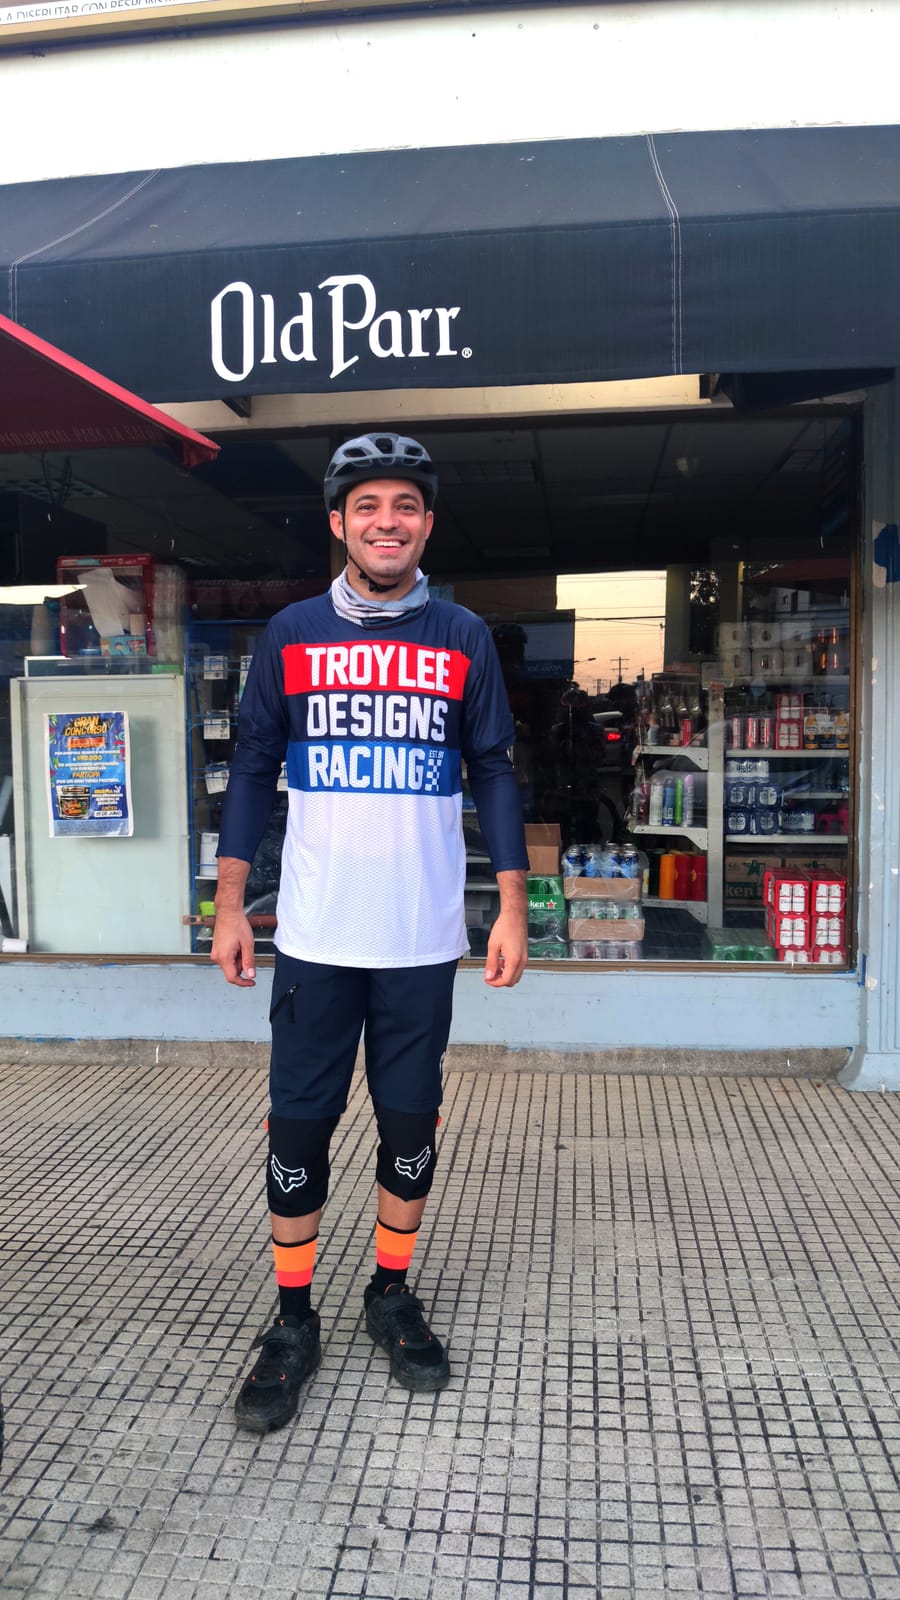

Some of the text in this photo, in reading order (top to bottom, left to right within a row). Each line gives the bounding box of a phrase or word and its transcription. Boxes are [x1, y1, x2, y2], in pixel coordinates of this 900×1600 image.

[210, 281, 318, 382] Old
[64, 723, 108, 737] CONCURSO
[74, 715, 99, 728] GRAN
[307, 693, 449, 743] DESIGNS
[308, 745, 426, 791] RACING
[528, 900, 545, 909] ken
